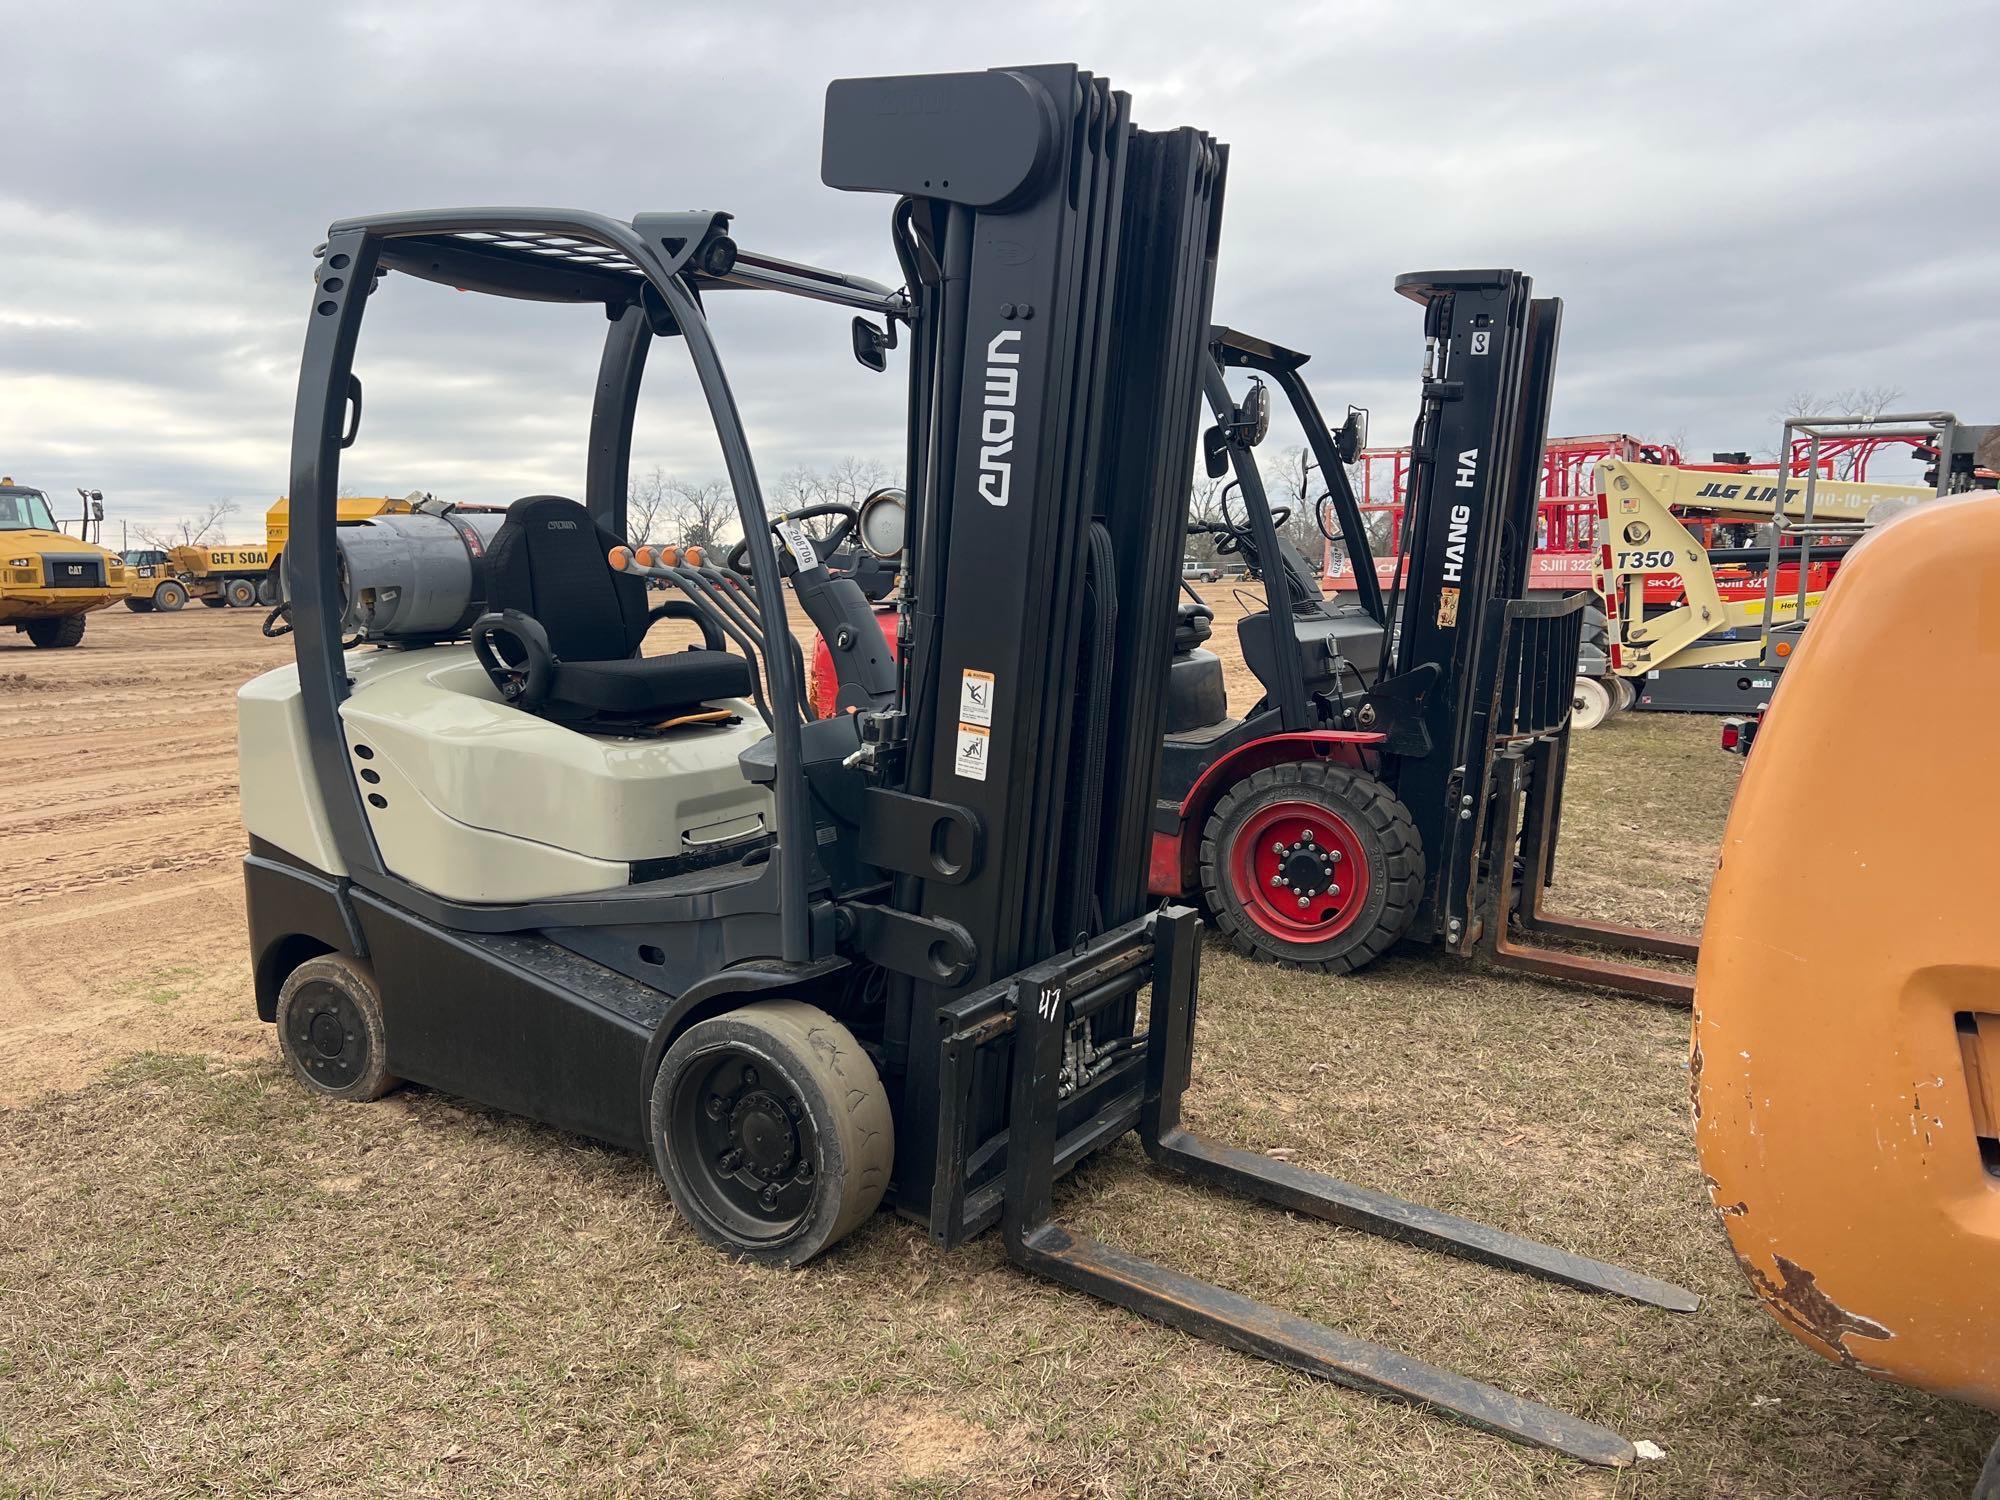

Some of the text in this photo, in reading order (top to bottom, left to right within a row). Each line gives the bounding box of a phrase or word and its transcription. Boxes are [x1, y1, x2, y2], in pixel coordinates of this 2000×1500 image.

[978, 329, 1021, 507] CROWN
[1696, 482, 1742, 499] JLG
[1442, 448, 1479, 582] HANG HA
[547, 520, 578, 530] CROWN
[790, 529, 814, 564] 208706
[211, 552, 235, 564] GET
[1540, 559, 1593, 572] SJIII 322
[1617, 550, 1675, 569] T350
[68, 565, 83, 575] CAT
[139, 568, 151, 577] CAT
[1746, 577, 1768, 588] 321
[1038, 987, 1062, 1023] 47
